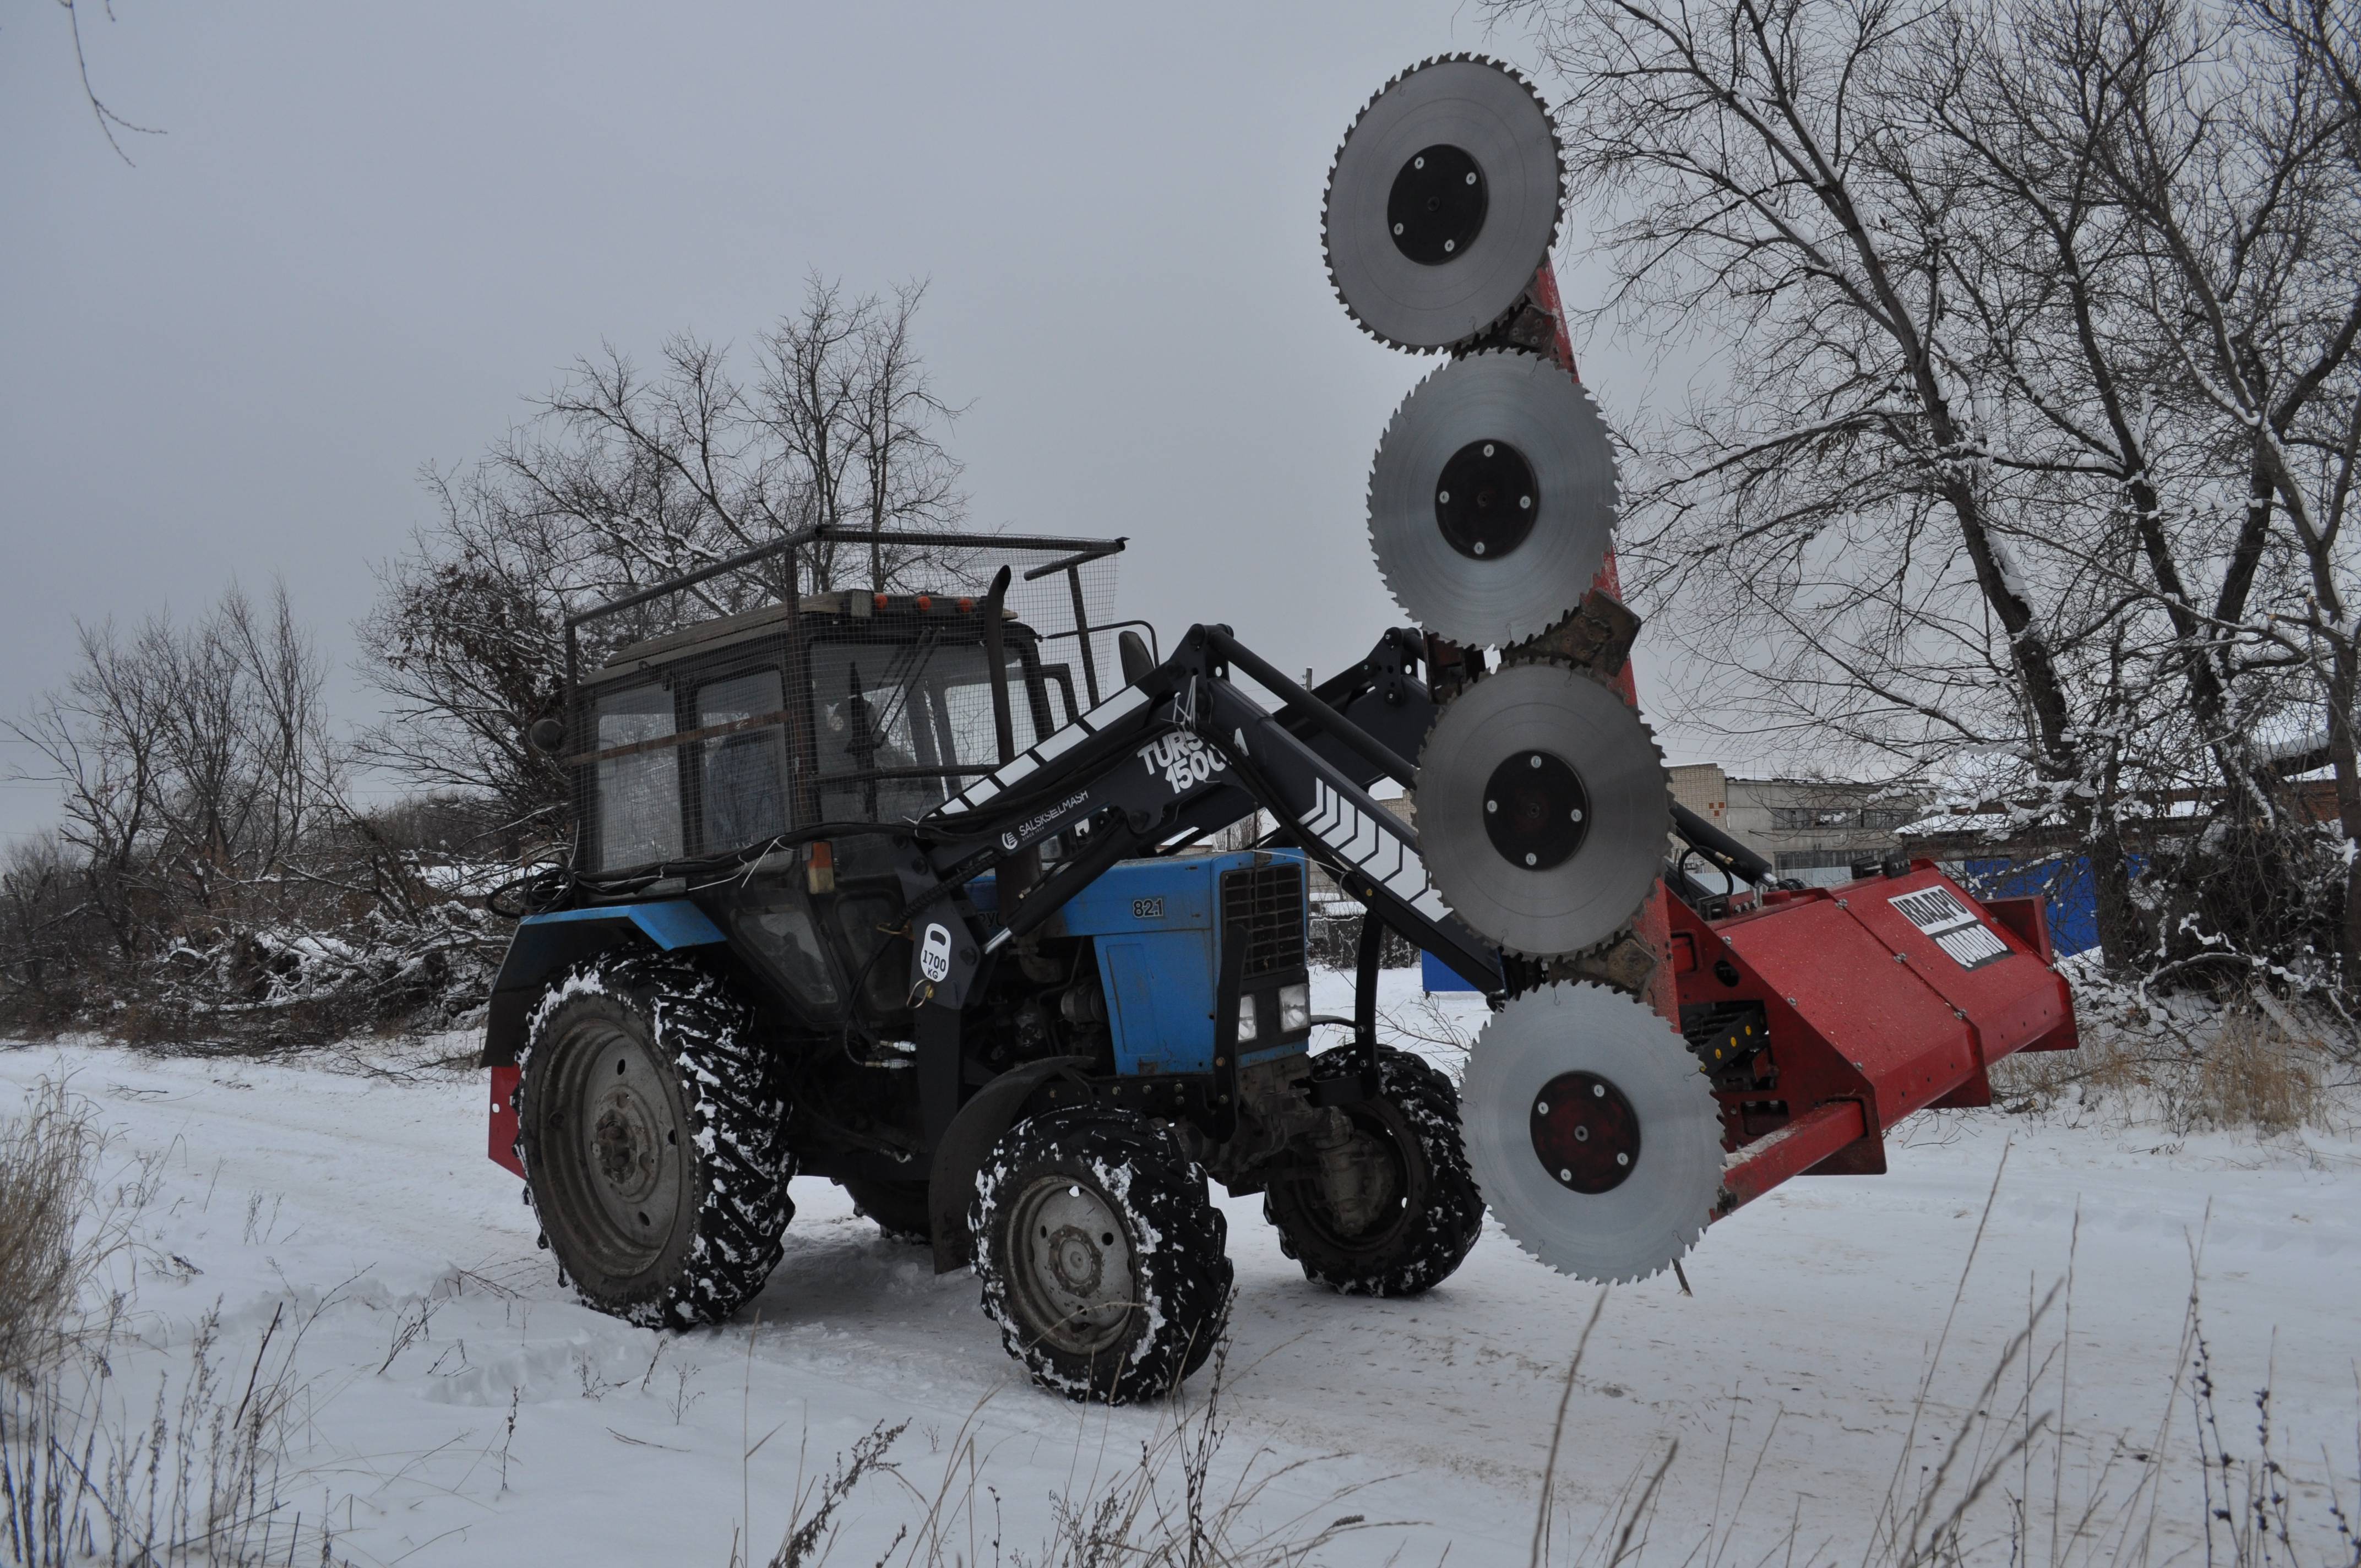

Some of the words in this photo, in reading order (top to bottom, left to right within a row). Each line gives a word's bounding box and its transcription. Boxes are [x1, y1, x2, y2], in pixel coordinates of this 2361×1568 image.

[1137, 730, 1204, 775] TURS
[1165, 743, 1231, 794] 1500
[1019, 790, 1089, 836] SALSKSELMASH
[1133, 898, 1163, 918] 82.1
[1894, 889, 1967, 927] КВАДРО
[923, 950, 946, 972] 1700
[1935, 924, 2008, 967] QUADRO
[928, 967, 938, 979] KG
